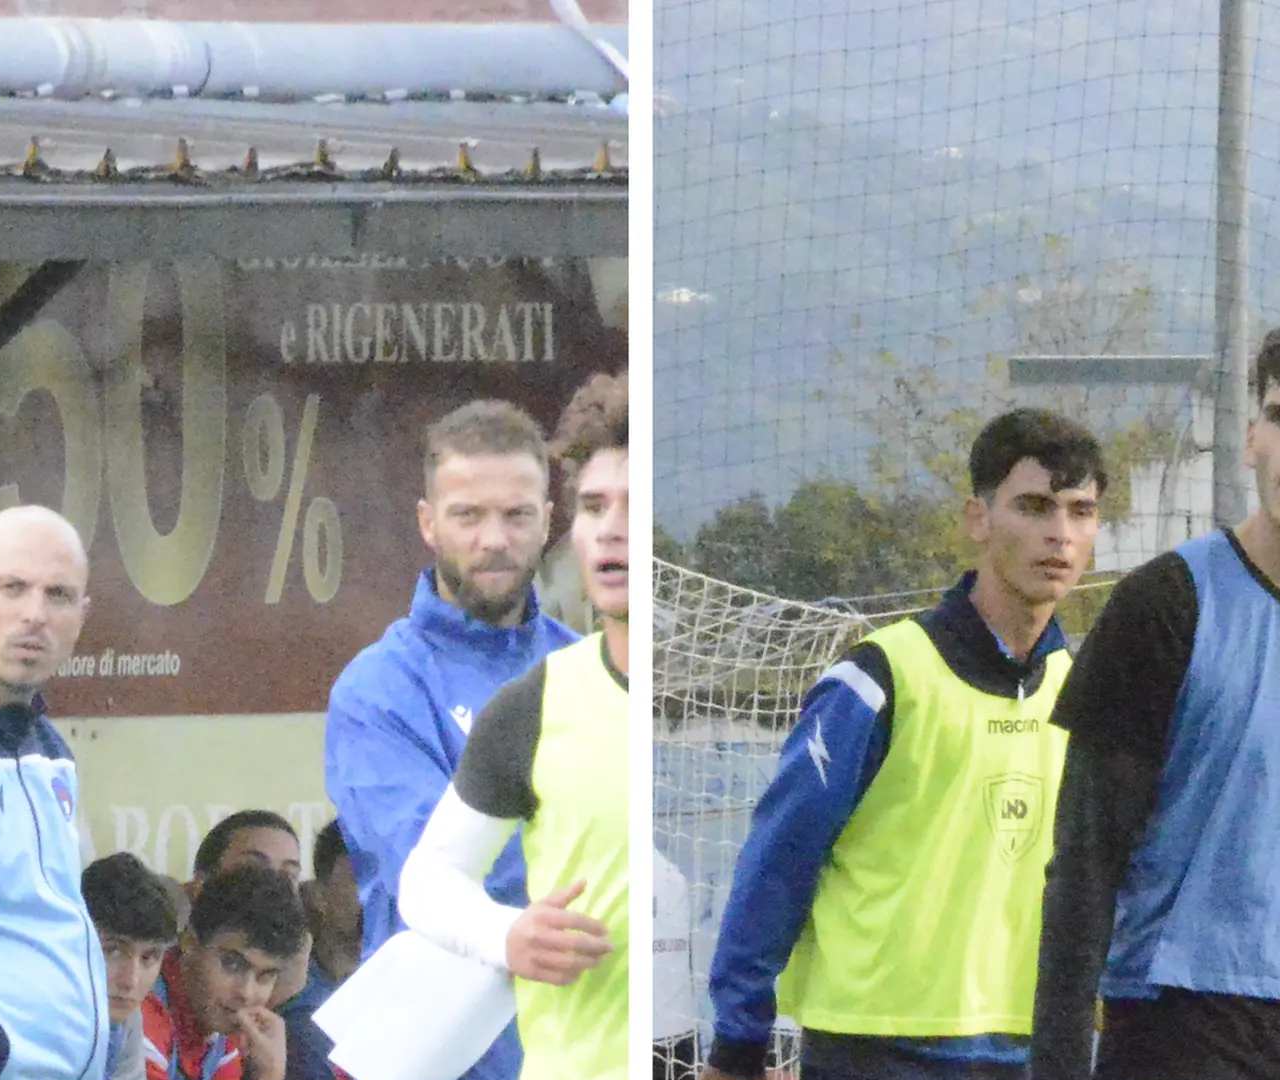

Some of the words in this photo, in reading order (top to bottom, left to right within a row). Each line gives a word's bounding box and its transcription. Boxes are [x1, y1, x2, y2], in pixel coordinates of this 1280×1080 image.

[280, 321, 297, 364] e
[307, 302, 556, 363] RIGENERATI
[100, 648, 116, 676] di
[118, 650, 181, 676] mercato
